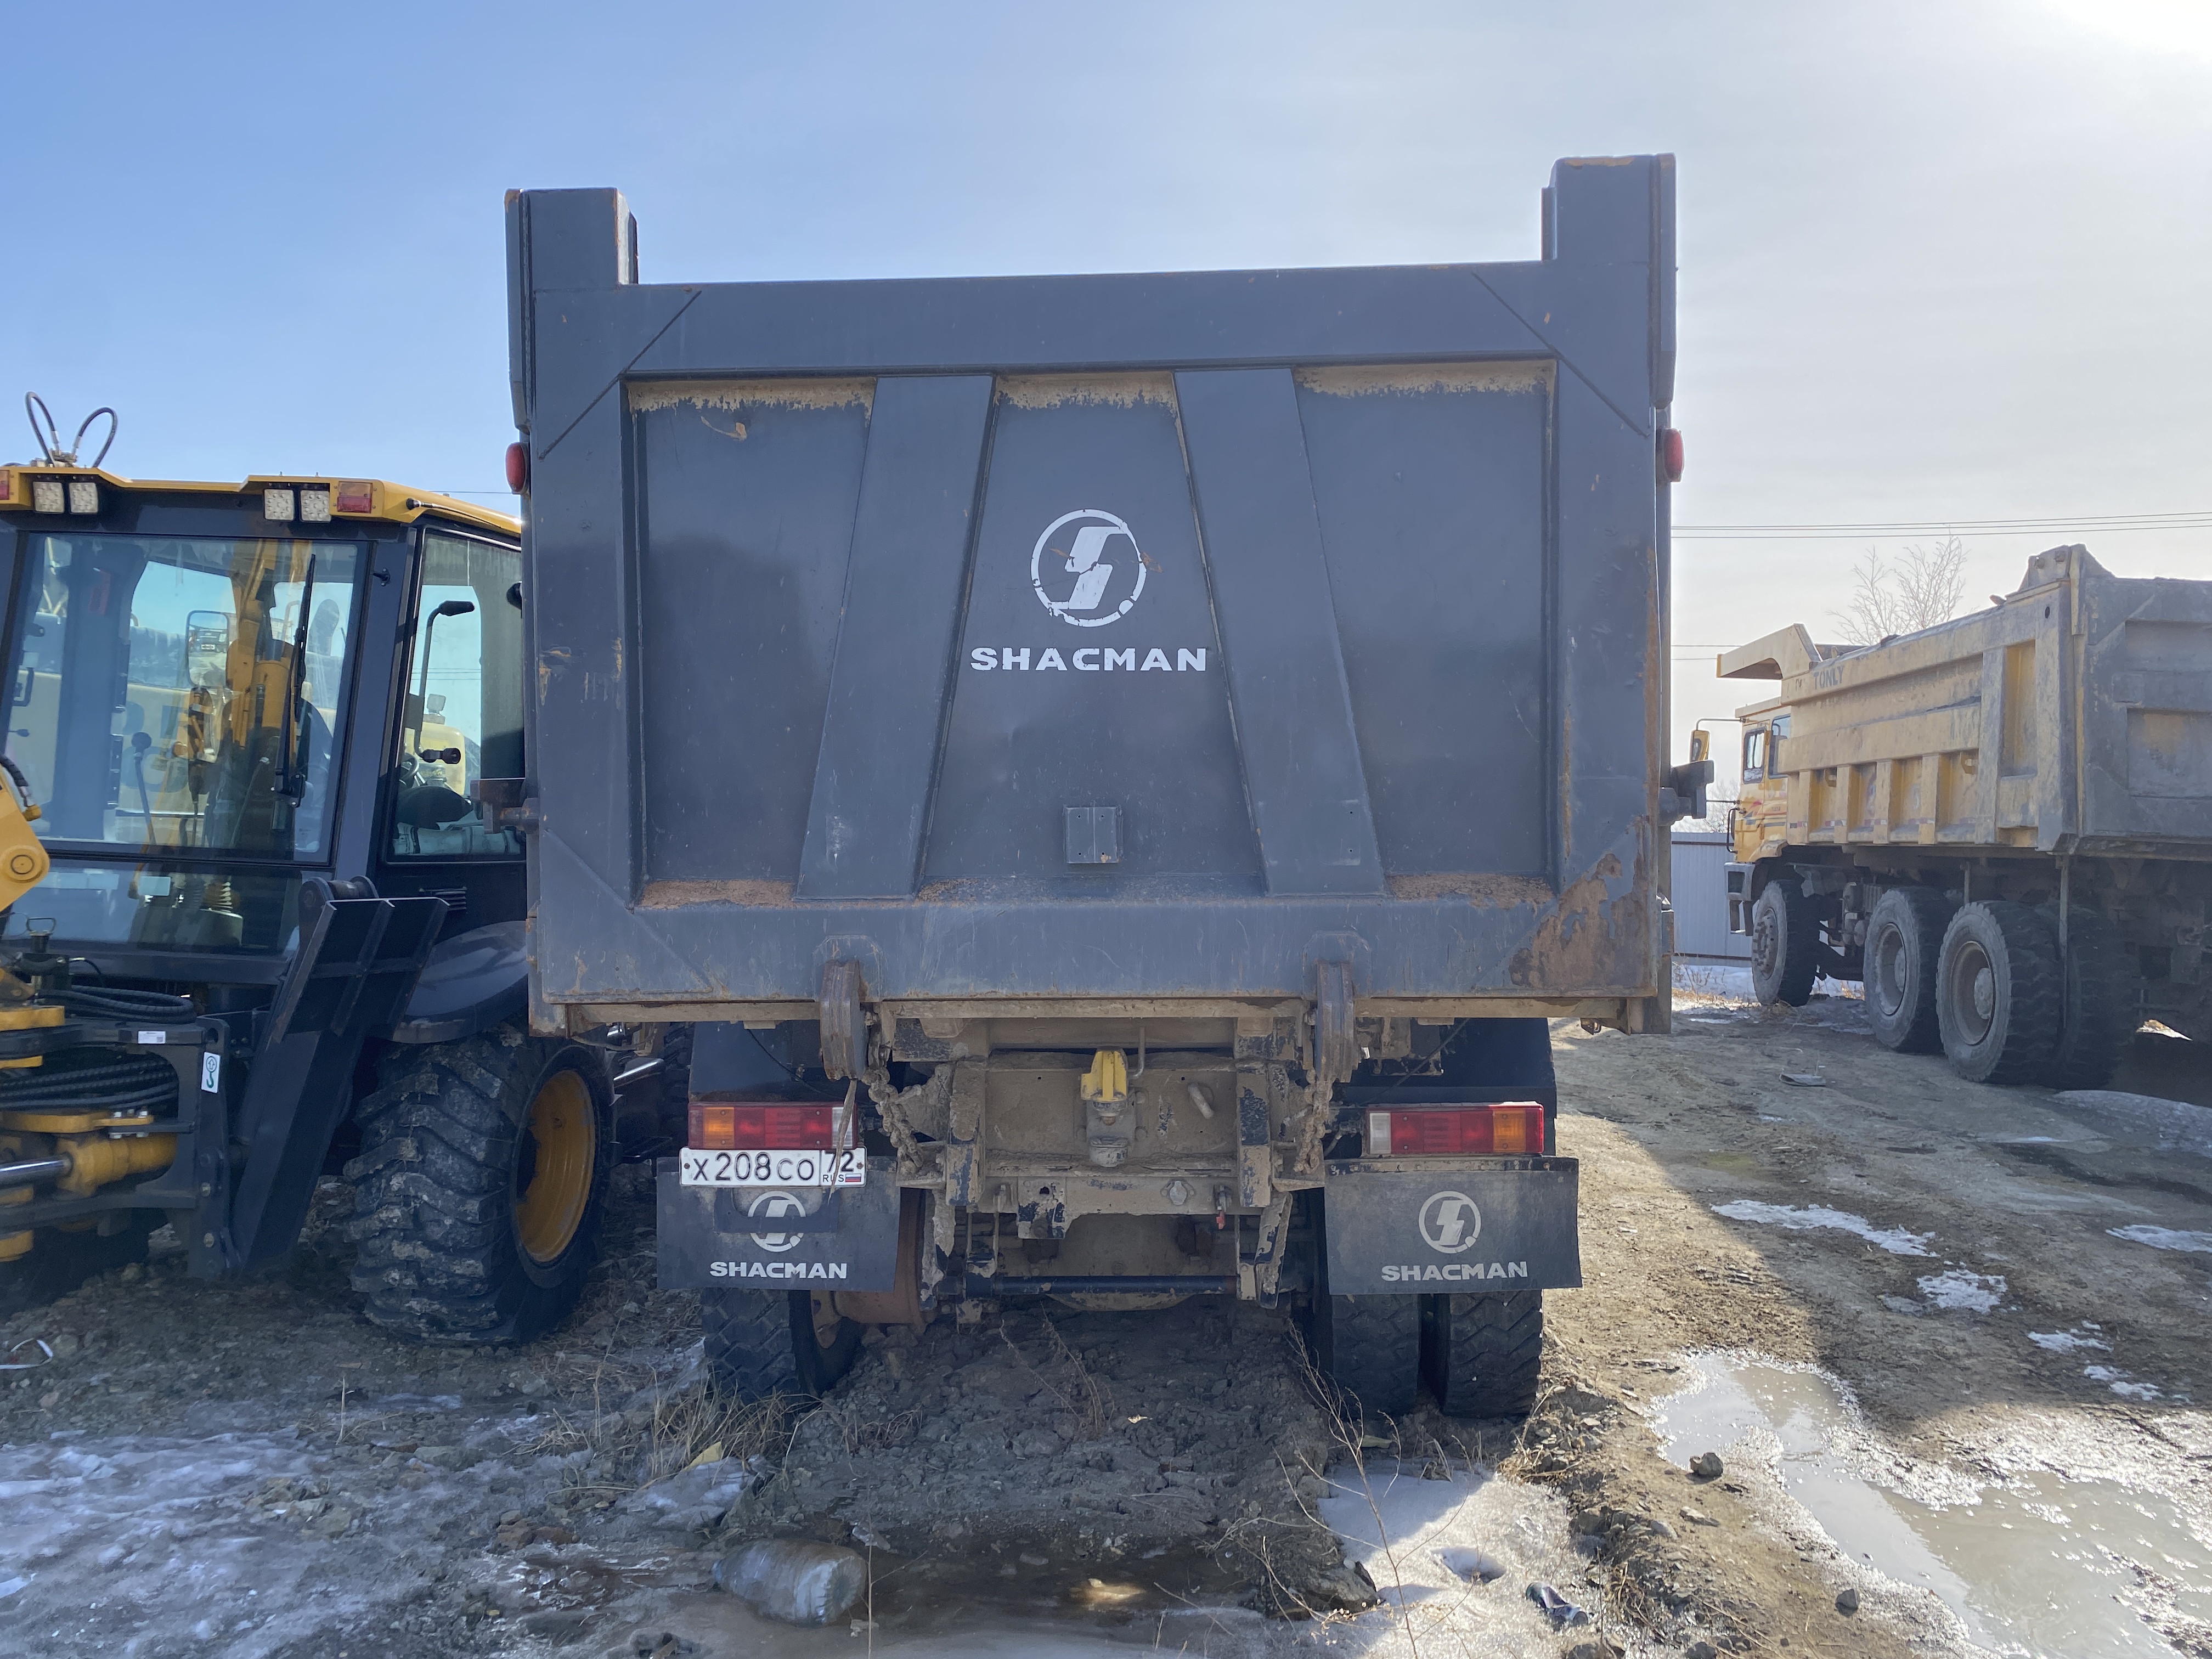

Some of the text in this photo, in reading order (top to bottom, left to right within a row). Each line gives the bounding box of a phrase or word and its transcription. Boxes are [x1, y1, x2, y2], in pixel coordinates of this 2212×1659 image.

[970, 647, 1206, 671] SHACMAN
[1813, 665, 1844, 690] TONLY
[825, 1149, 854, 1172] 72
[710, 1262, 847, 1279] SHACMAN
[1381, 1261, 1528, 1282] SHACMAN
